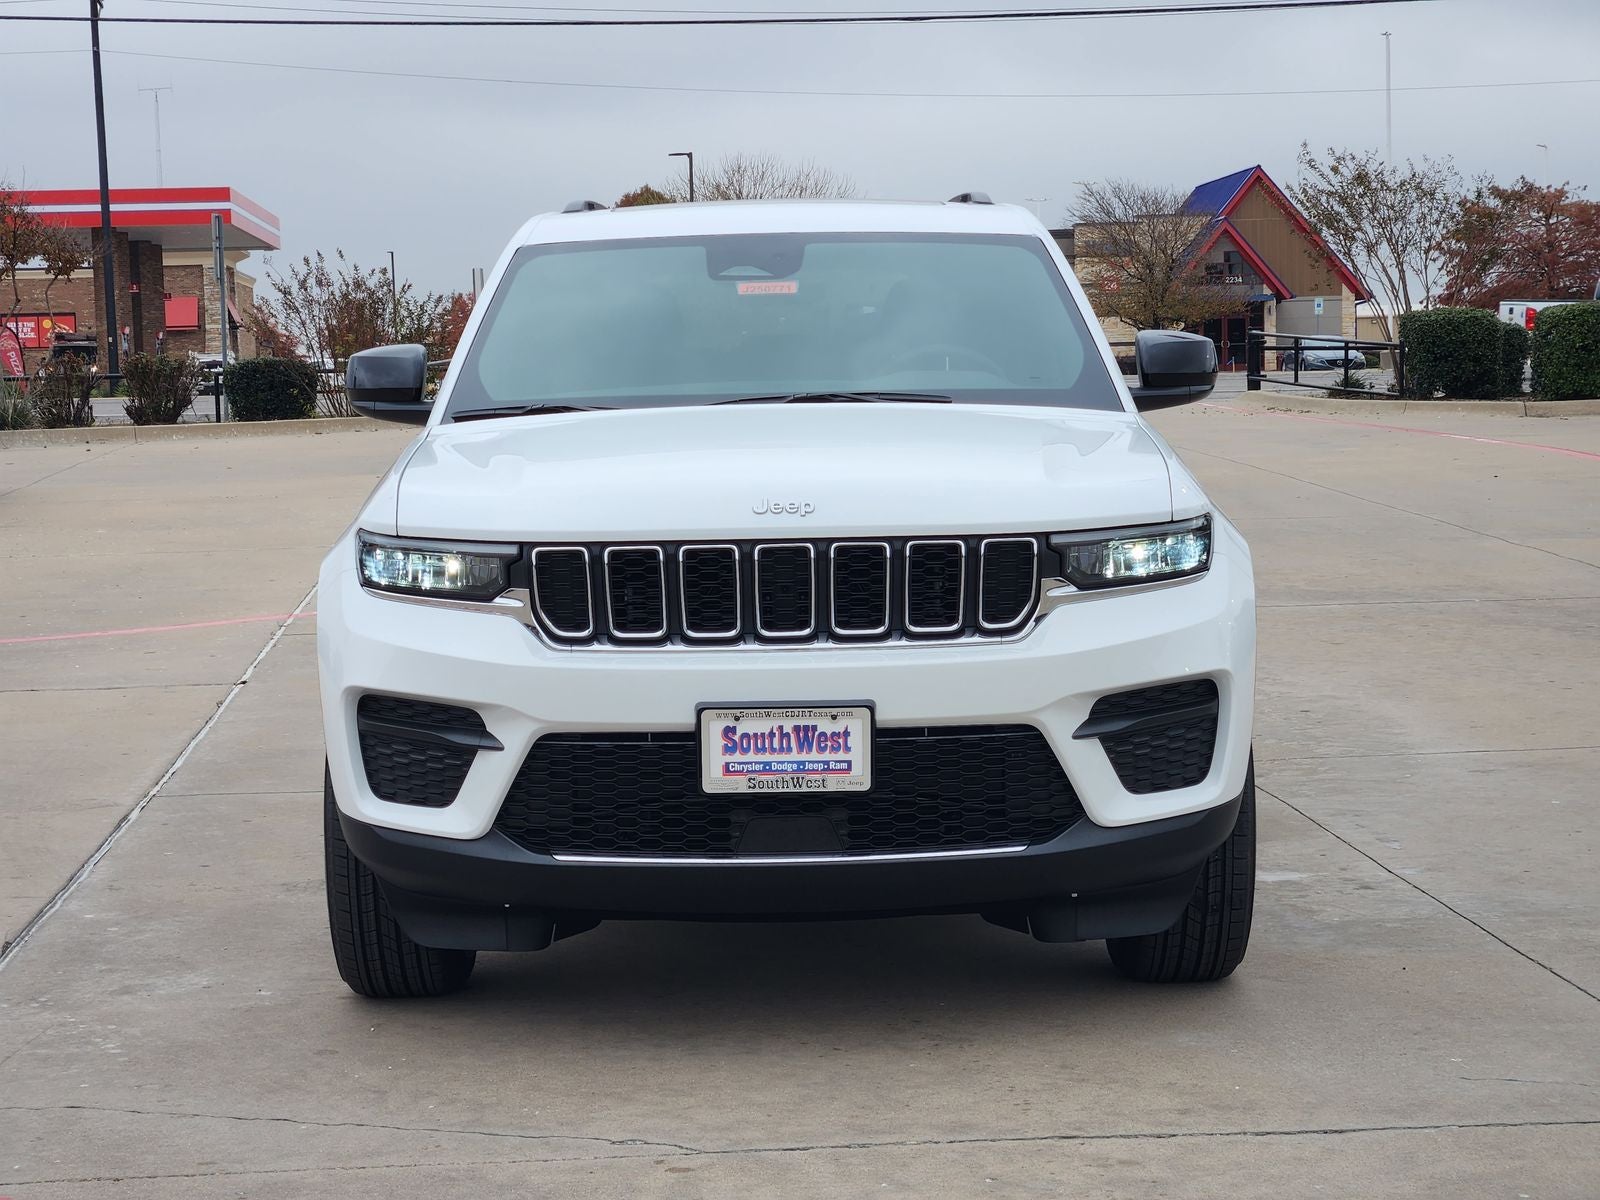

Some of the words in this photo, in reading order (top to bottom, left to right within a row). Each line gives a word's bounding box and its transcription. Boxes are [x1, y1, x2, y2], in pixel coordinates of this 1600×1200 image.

[752, 497, 815, 517] Jeep
[721, 724, 852, 756] SouthWest
[729, 762, 764, 772] Chrysler
[771, 762, 798, 772] Dodge
[804, 761, 824, 771] Jeep
[829, 761, 848, 770] Ram
[747, 776, 828, 790] SouthWest
